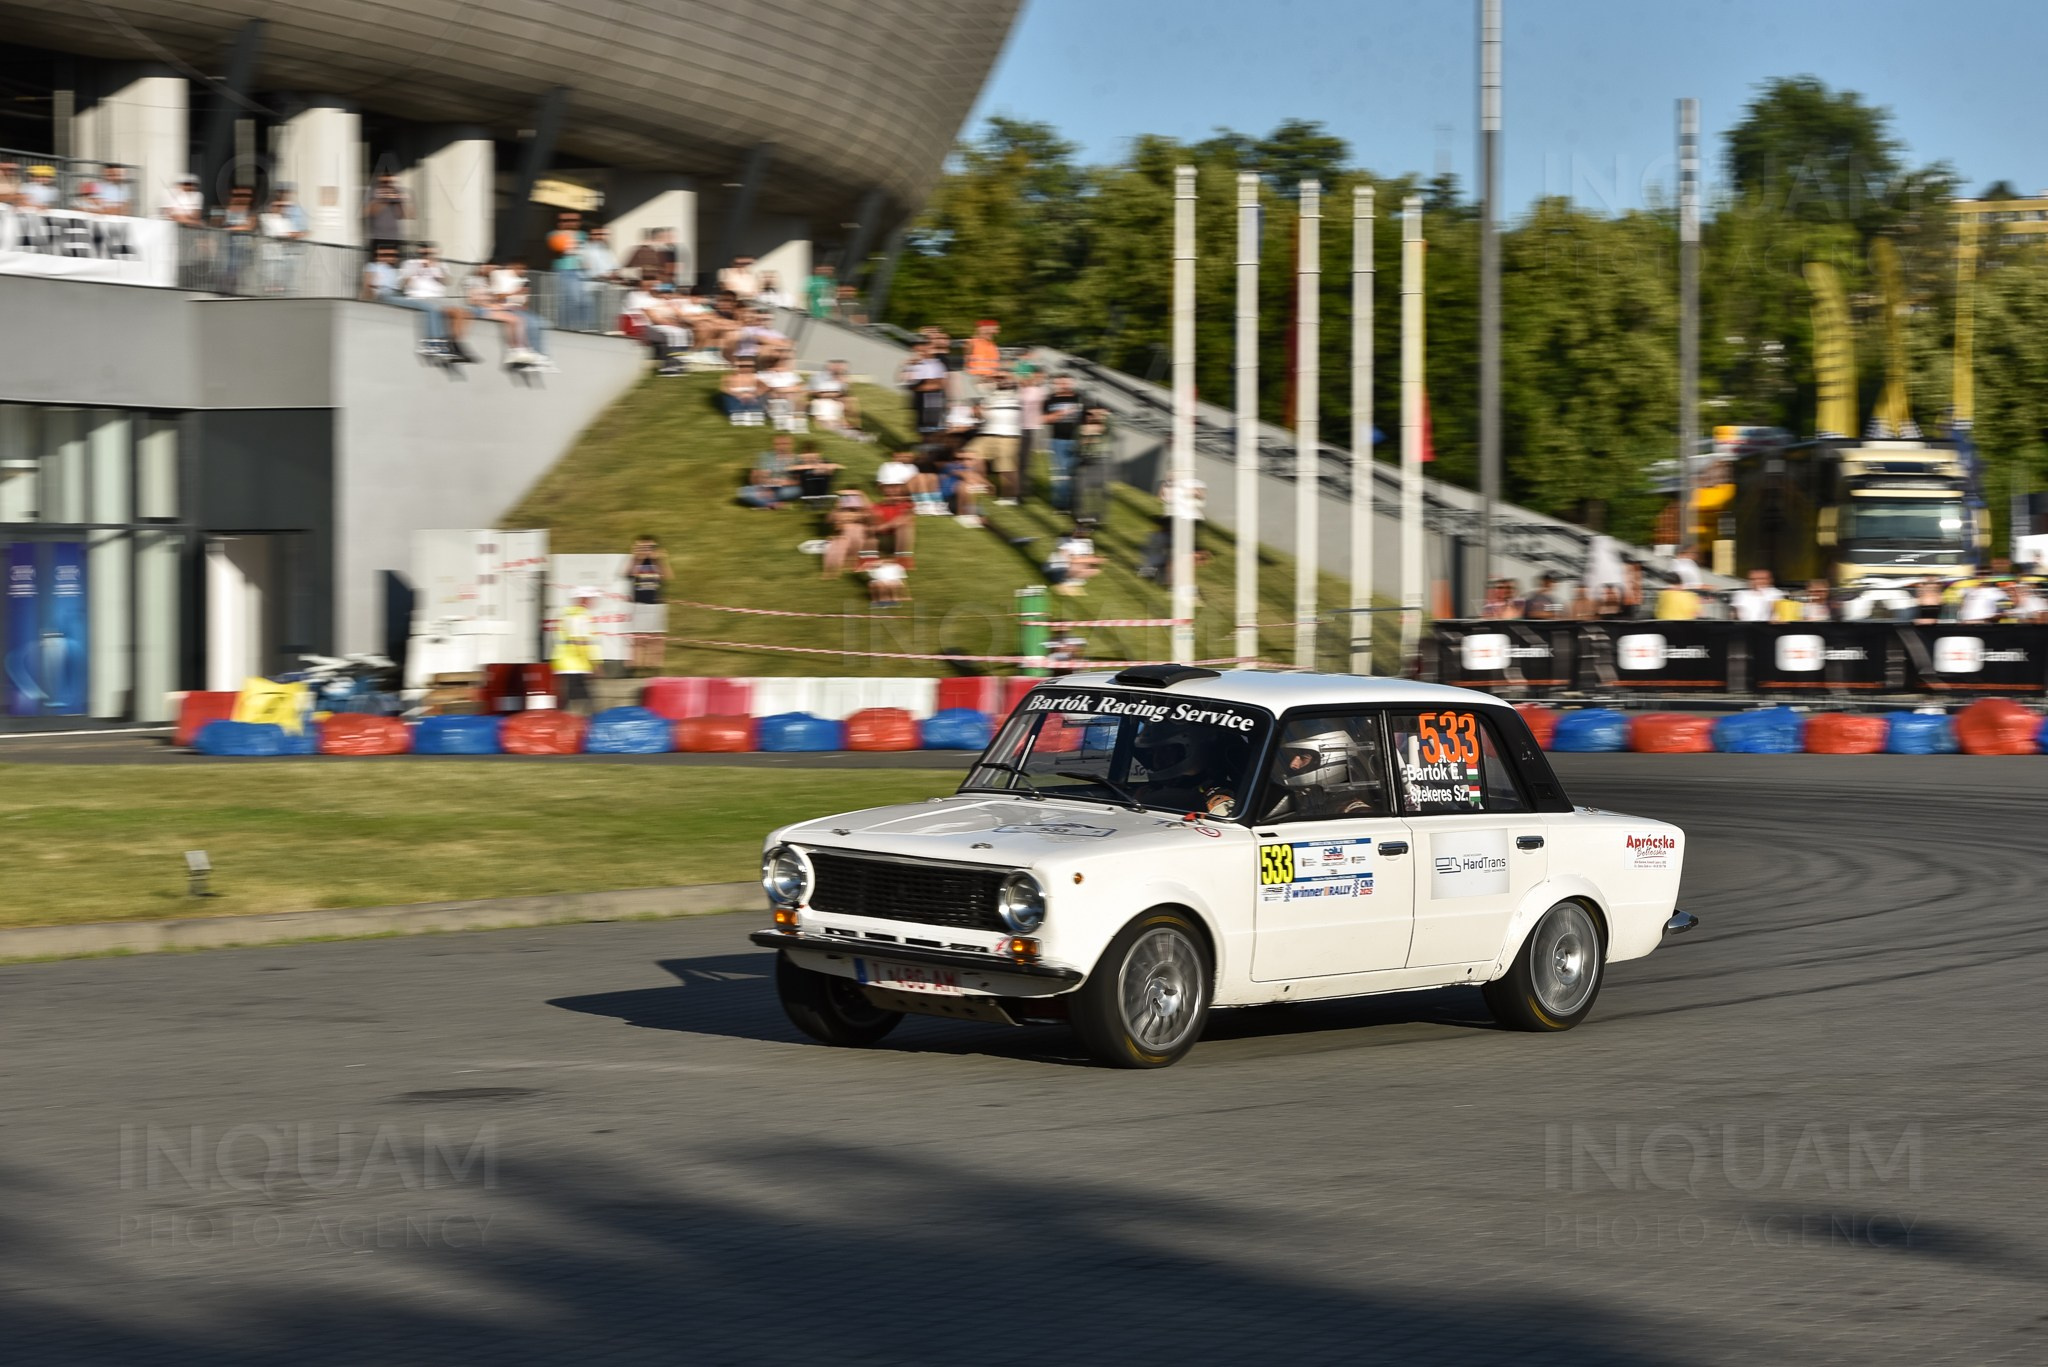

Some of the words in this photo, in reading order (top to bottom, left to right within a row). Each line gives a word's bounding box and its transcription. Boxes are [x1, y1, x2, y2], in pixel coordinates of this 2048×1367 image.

[1025, 694, 1094, 712] Bartók
[1094, 697, 1171, 722] Racing
[1171, 703, 1255, 732] Service
[1418, 711, 1479, 764] 533
[1407, 762, 1448, 781] Bartók
[1410, 785, 1452, 802] Szekeres
[1454, 785, 1469, 801] Sz.
[1626, 834, 1675, 850] Aprócska
[1261, 844, 1294, 884] 533
[1463, 857, 1506, 870] HardTrans
[1292, 885, 1324, 898] winner
[1329, 885, 1352, 896] RALLY
